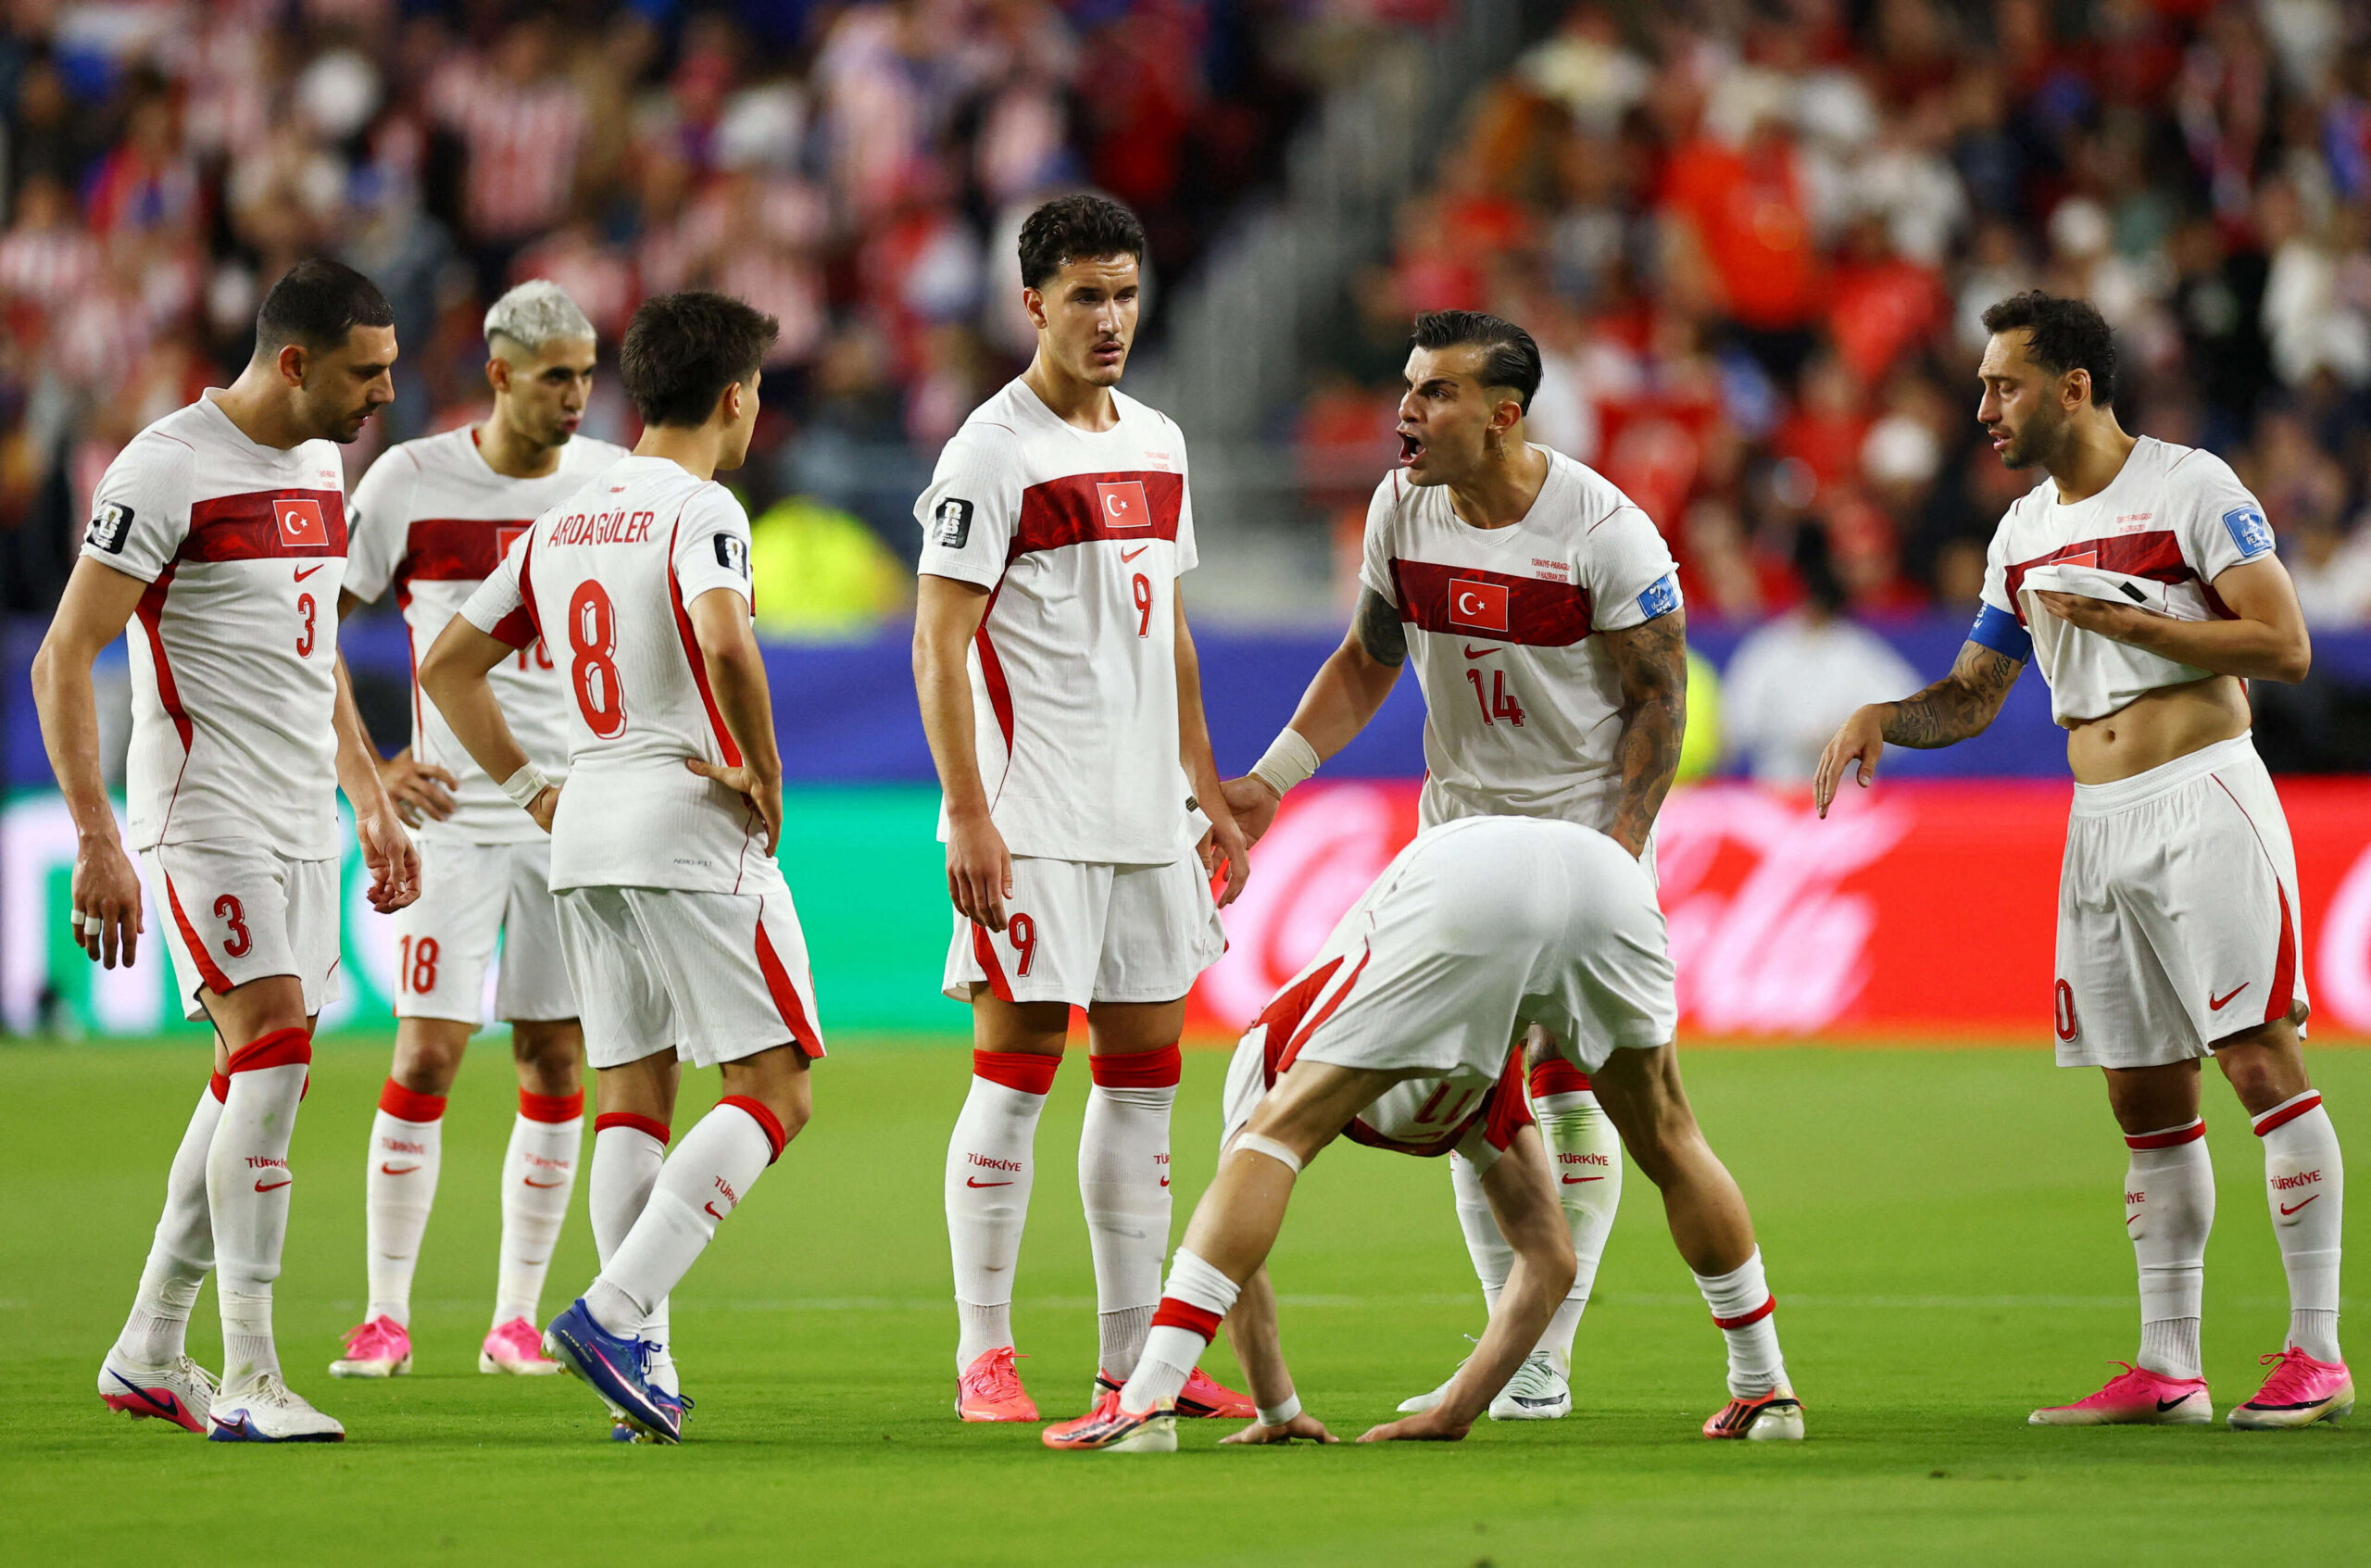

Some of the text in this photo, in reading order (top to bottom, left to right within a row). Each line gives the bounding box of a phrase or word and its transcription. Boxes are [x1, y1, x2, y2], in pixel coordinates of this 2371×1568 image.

[547, 507, 655, 548] ARDAGÜLER
[296, 592, 317, 659] 3
[1133, 573, 1153, 638] 9
[569, 579, 627, 739] 8
[1466, 668, 1525, 728] 14
[213, 894, 253, 959] 3
[1009, 912, 1037, 978] 9
[401, 934, 441, 996] 18
[2055, 978, 2079, 1044] 0
[967, 1152, 1022, 1172] TÜRKİYE
[1557, 1152, 1609, 1166] TÜRKİYE
[2270, 1169, 2323, 1190] TÜRKİYE
